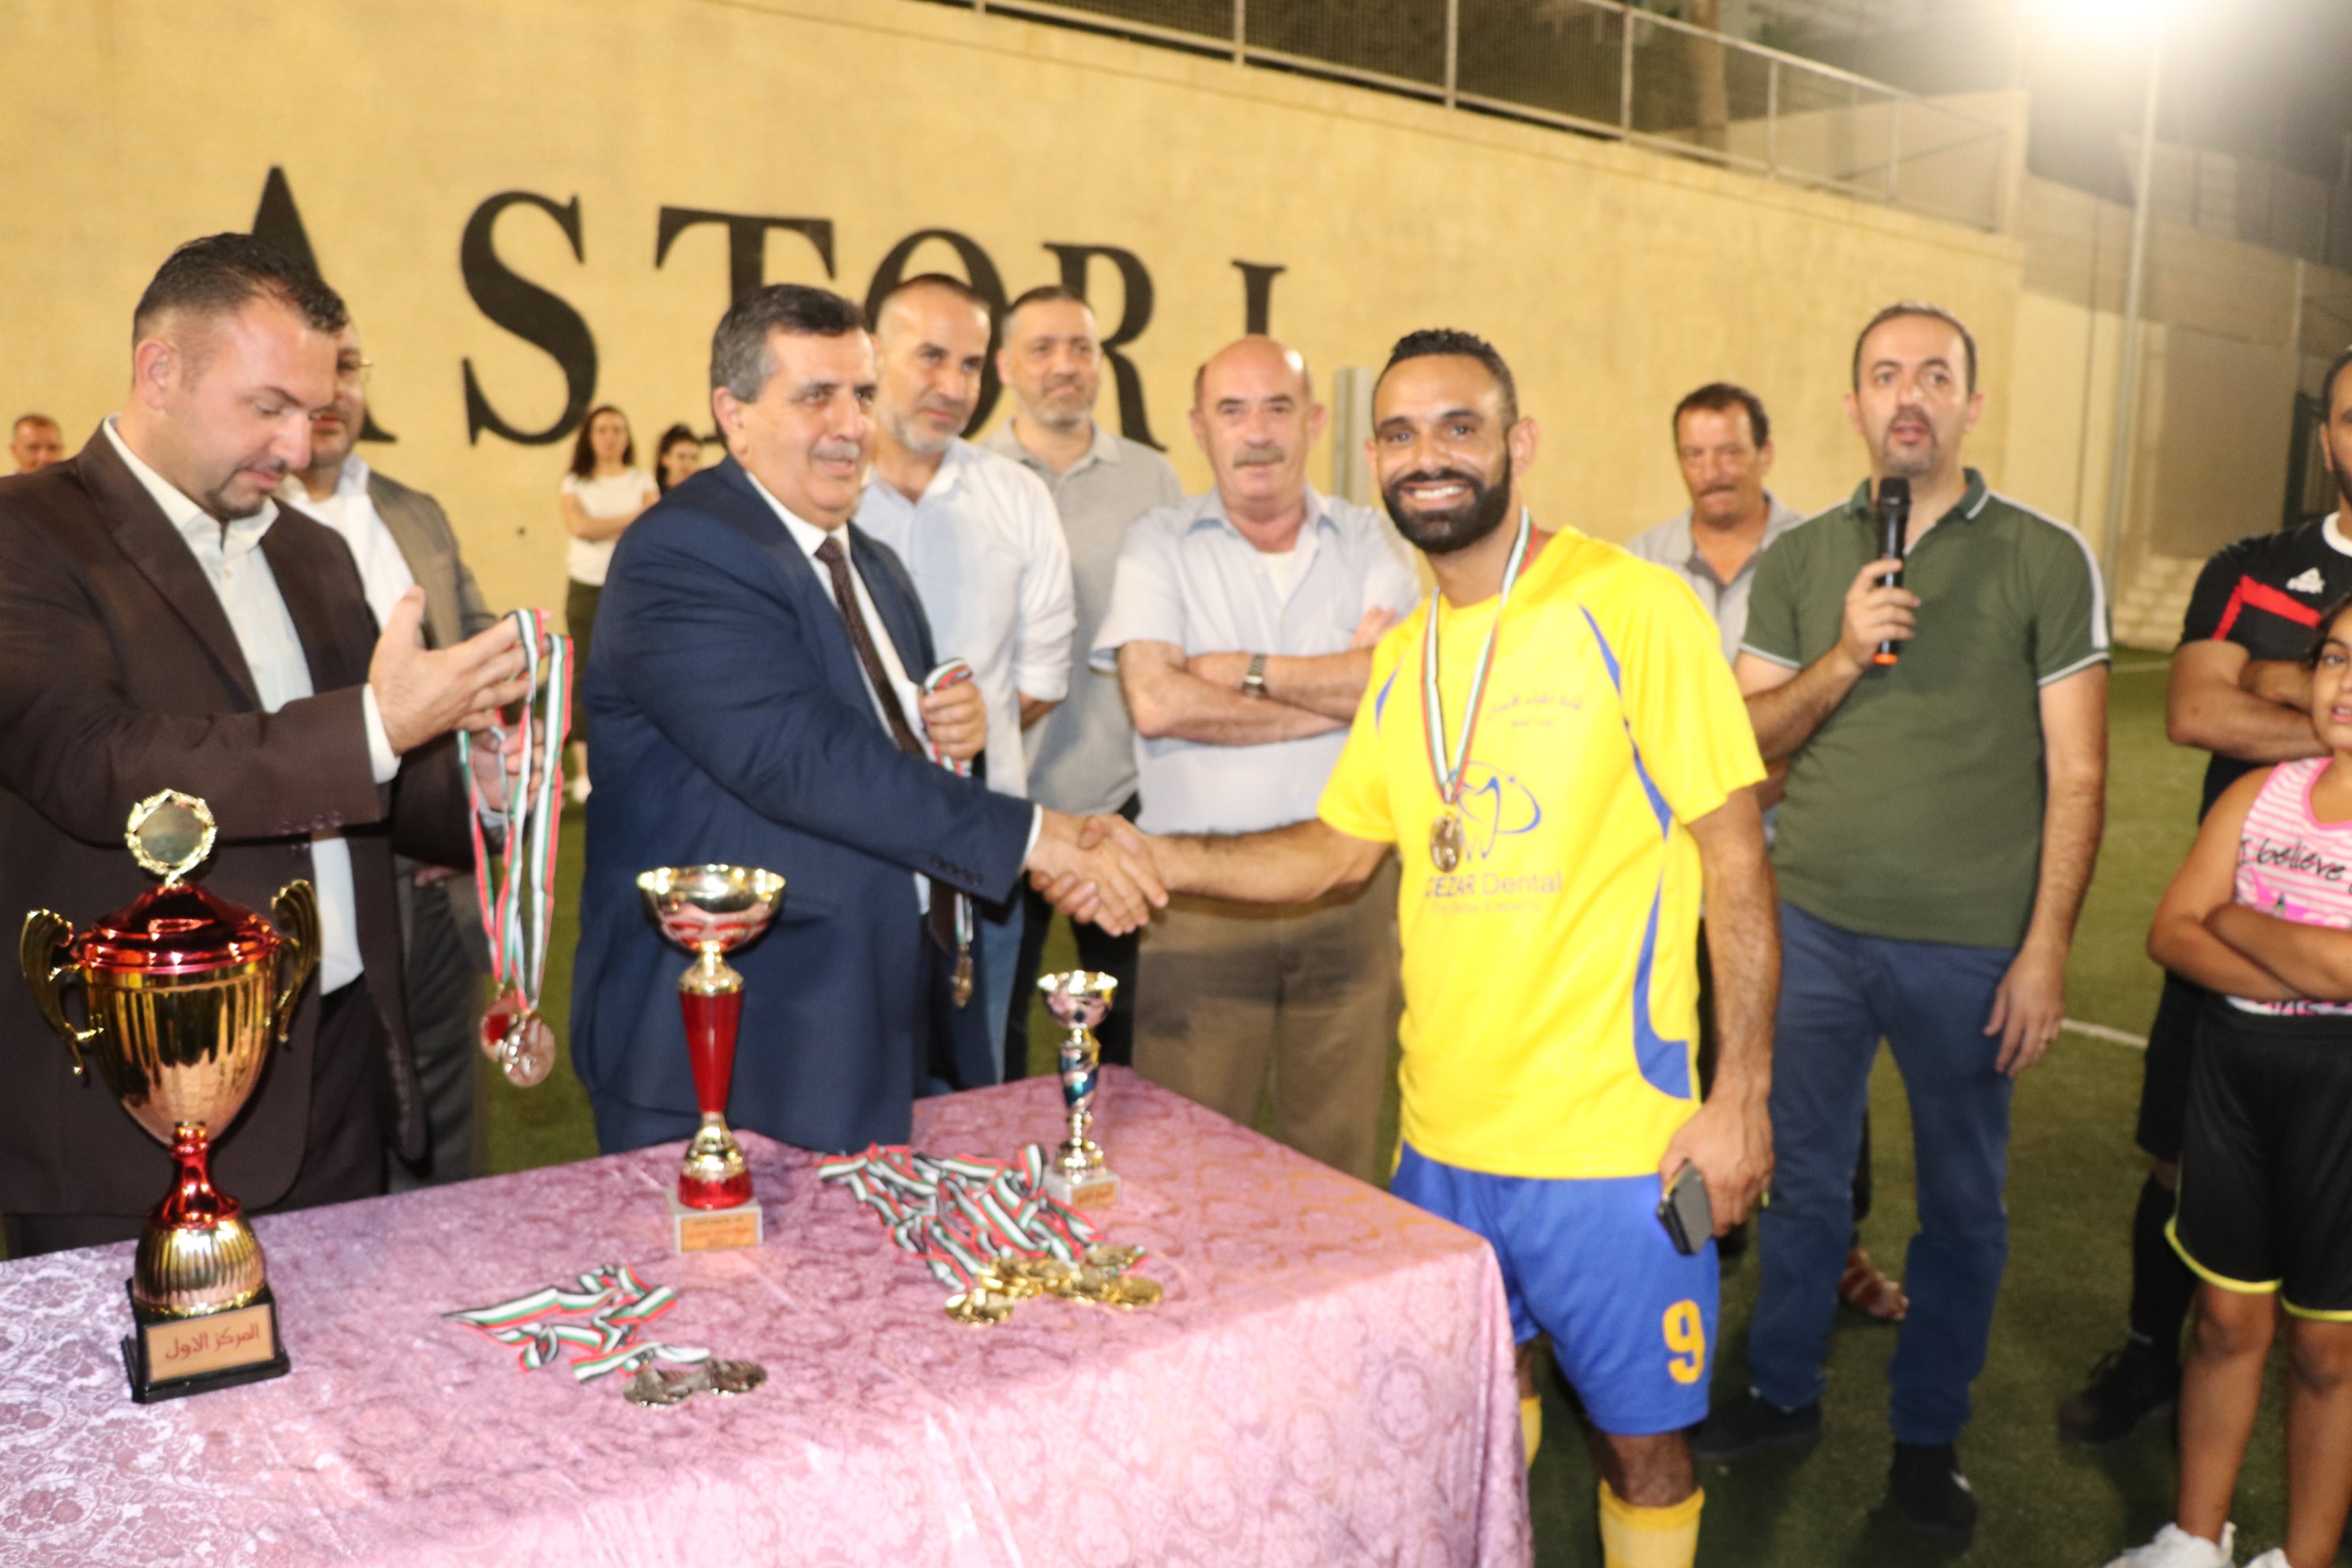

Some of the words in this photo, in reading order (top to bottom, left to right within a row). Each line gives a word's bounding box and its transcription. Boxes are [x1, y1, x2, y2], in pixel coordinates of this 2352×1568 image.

[2256, 838, 2346, 881] believe
[1482, 870, 1562, 895] Dental
[213, 1322, 261, 1351] المركز
[1662, 1298, 1706, 1385] 9
